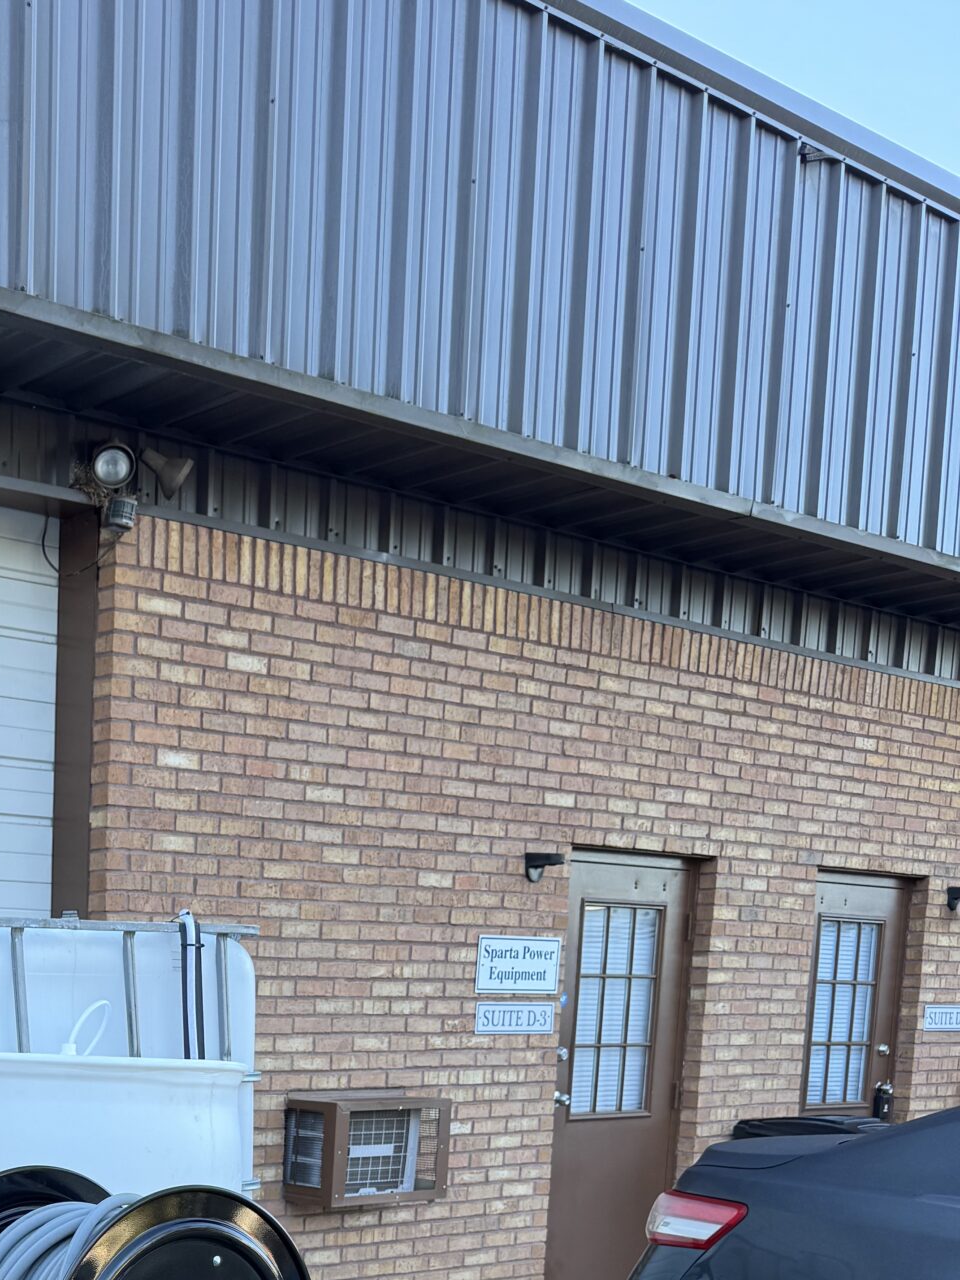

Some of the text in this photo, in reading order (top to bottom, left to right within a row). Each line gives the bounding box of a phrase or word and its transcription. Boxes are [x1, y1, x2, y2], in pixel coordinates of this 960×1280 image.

[483, 944, 555, 962] Sparta Power
[488, 966, 547, 984] Equipment
[482, 1010, 548, 1027] SUITE D-3
[928, 1011, 954, 1026] SUITE
